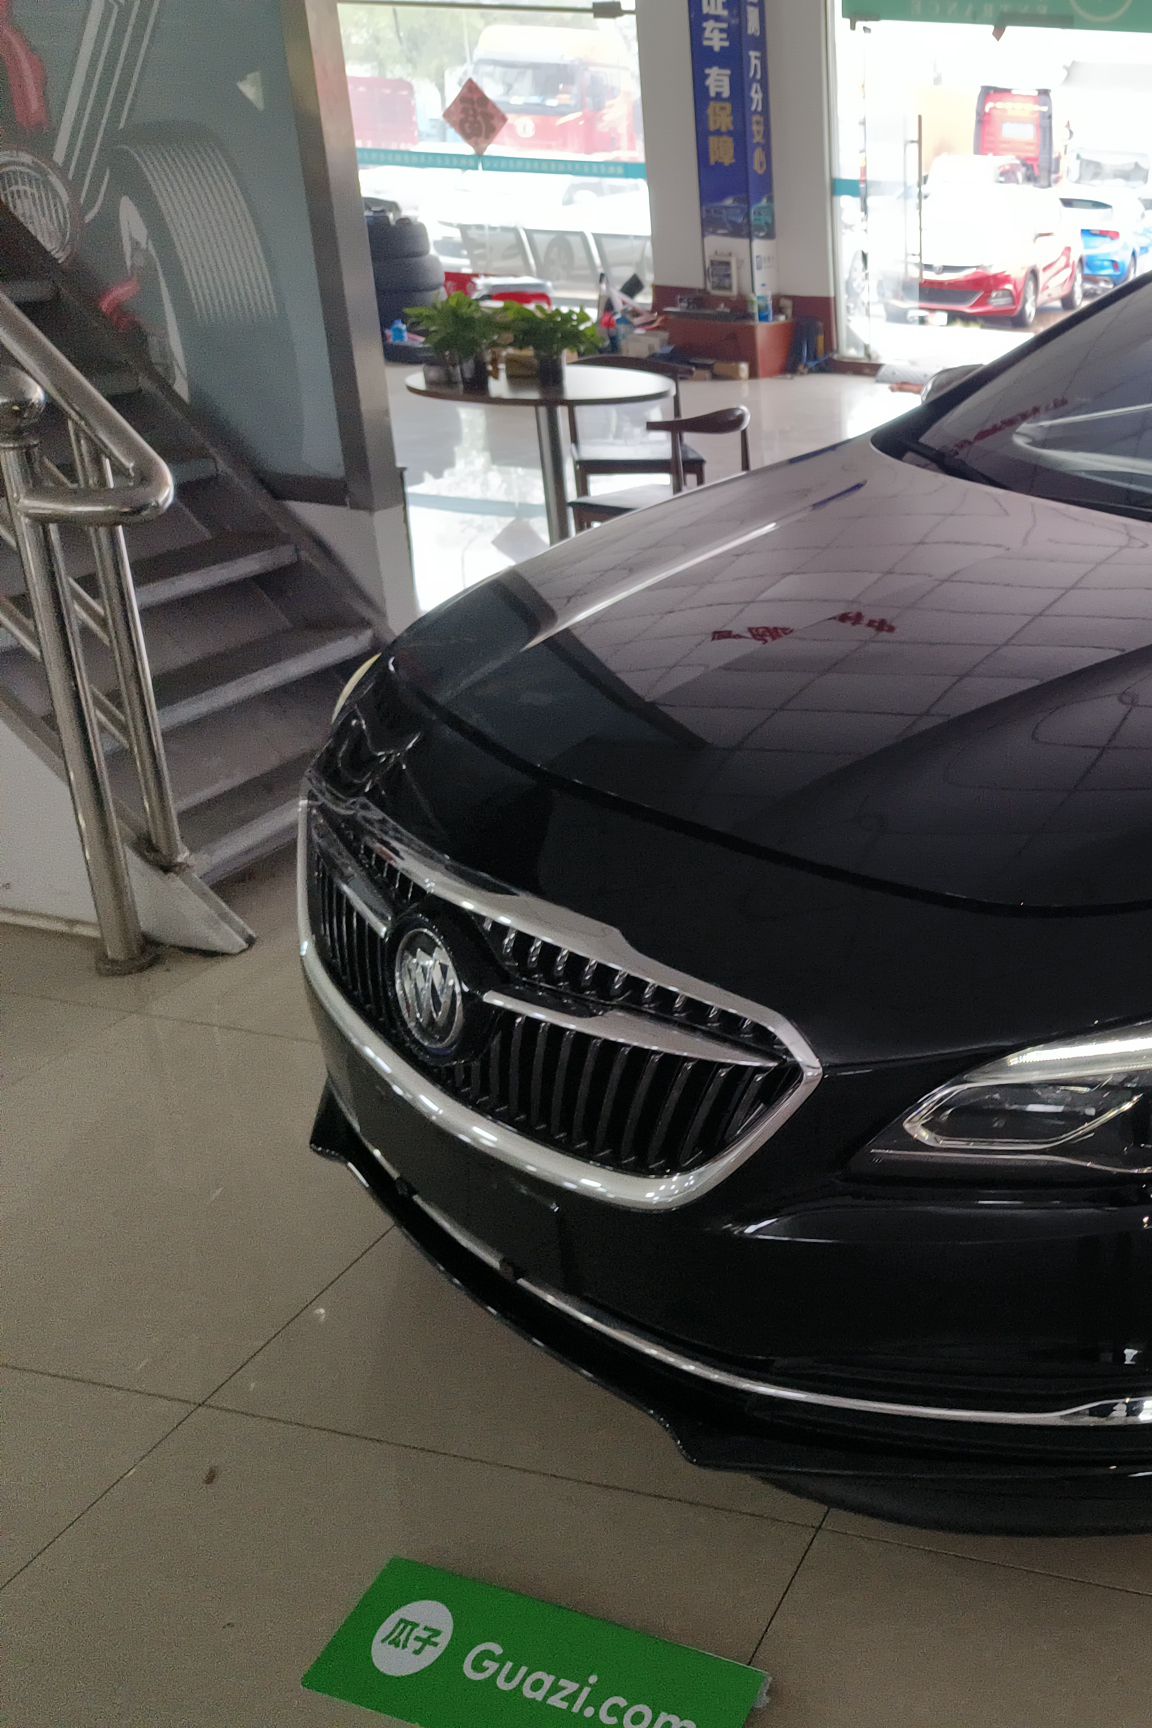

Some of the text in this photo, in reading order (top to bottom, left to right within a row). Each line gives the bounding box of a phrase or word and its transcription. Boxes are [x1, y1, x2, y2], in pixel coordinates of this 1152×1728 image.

[704, 66, 736, 167] 有保障
[380, 1617, 443, 1656] 瓜子
